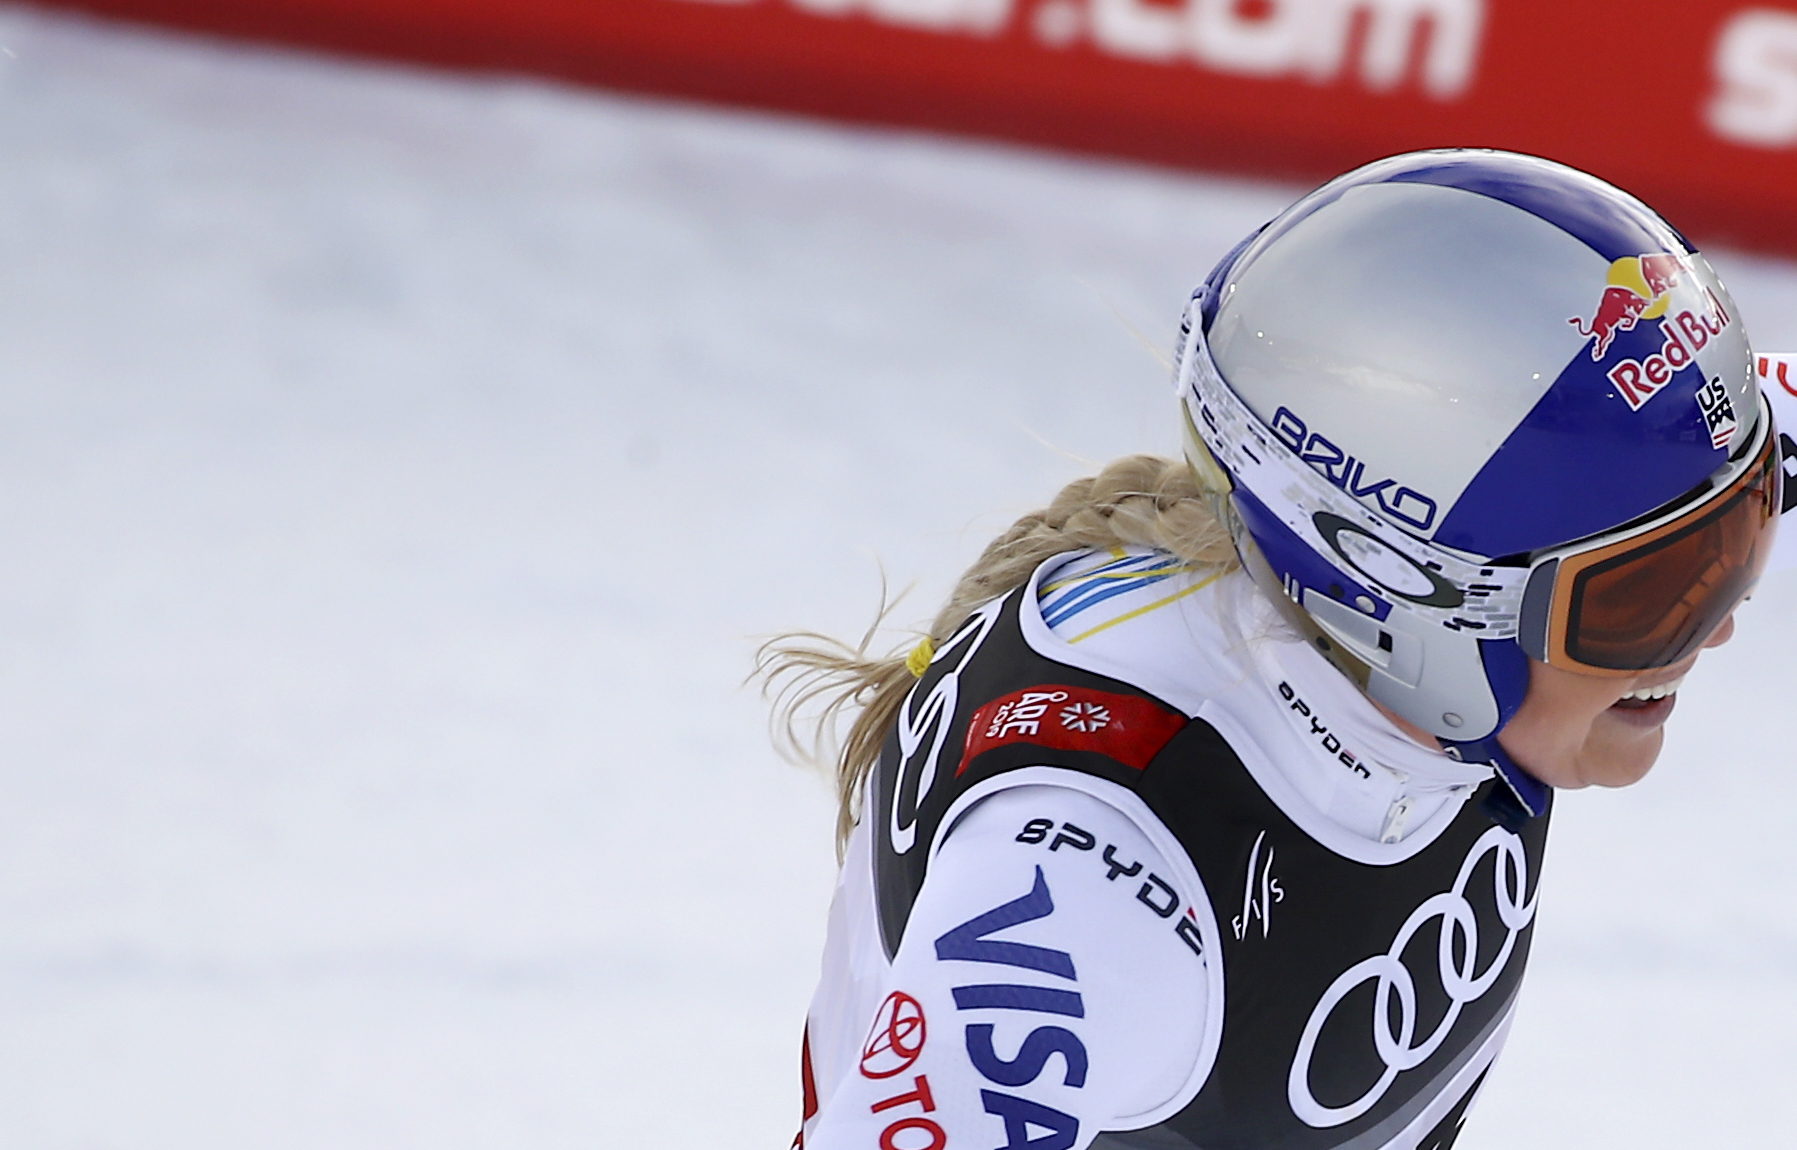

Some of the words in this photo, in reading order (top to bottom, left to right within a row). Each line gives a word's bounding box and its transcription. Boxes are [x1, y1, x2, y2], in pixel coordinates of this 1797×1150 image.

[1609, 321, 1693, 408] Red
[1674, 285, 1731, 352] Bull
[1271, 405, 1438, 532] BRIKO
[1278, 681, 1371, 780] SPYDER
[1015, 817, 1207, 967] SPYDE
